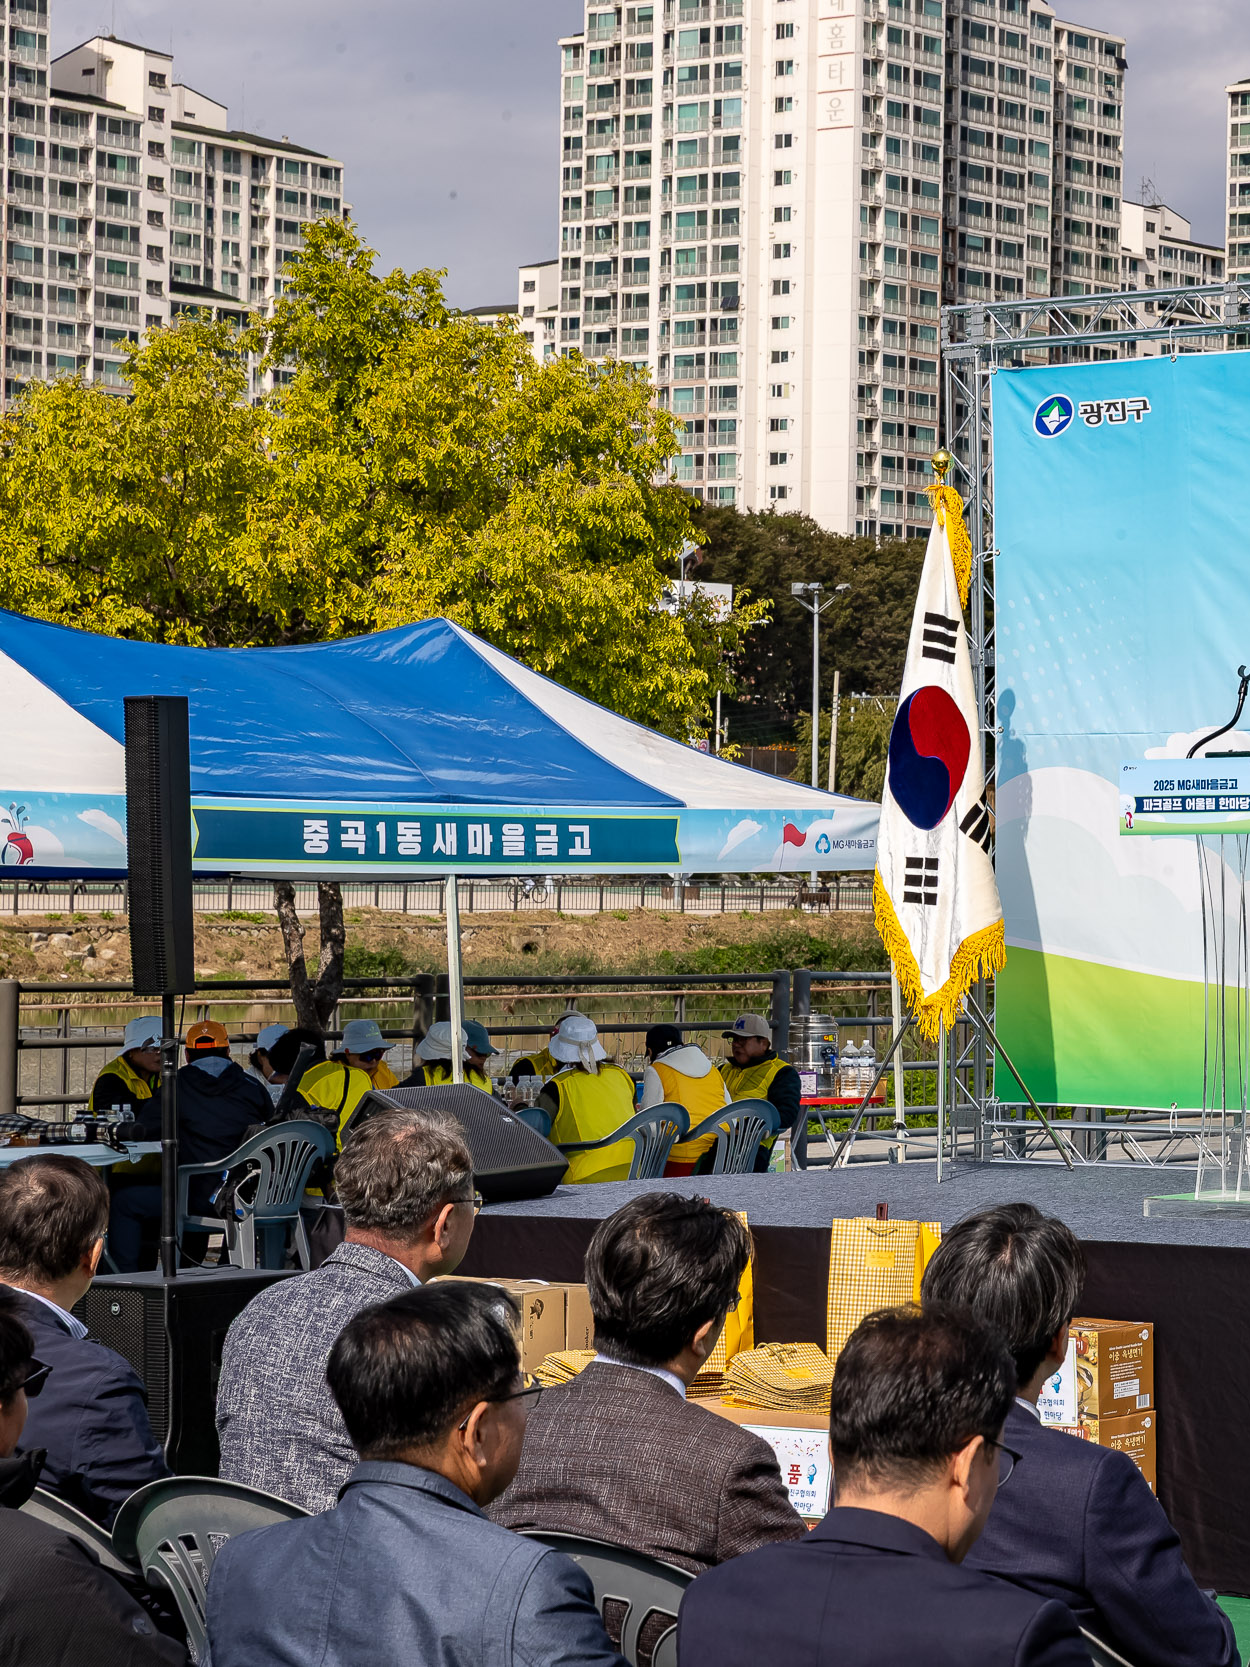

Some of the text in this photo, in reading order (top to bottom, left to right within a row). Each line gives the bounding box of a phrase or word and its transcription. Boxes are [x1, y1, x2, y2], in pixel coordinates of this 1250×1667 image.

[1079, 398, 1150, 425] 광진구
[1153, 778, 1238, 791] 2025 MG새마을금고
[1142, 796, 1250, 811] 파크골프 어울림 한마당
[832, 839, 875, 850] MG새마을금고
[787, 1464, 802, 1485] 품
